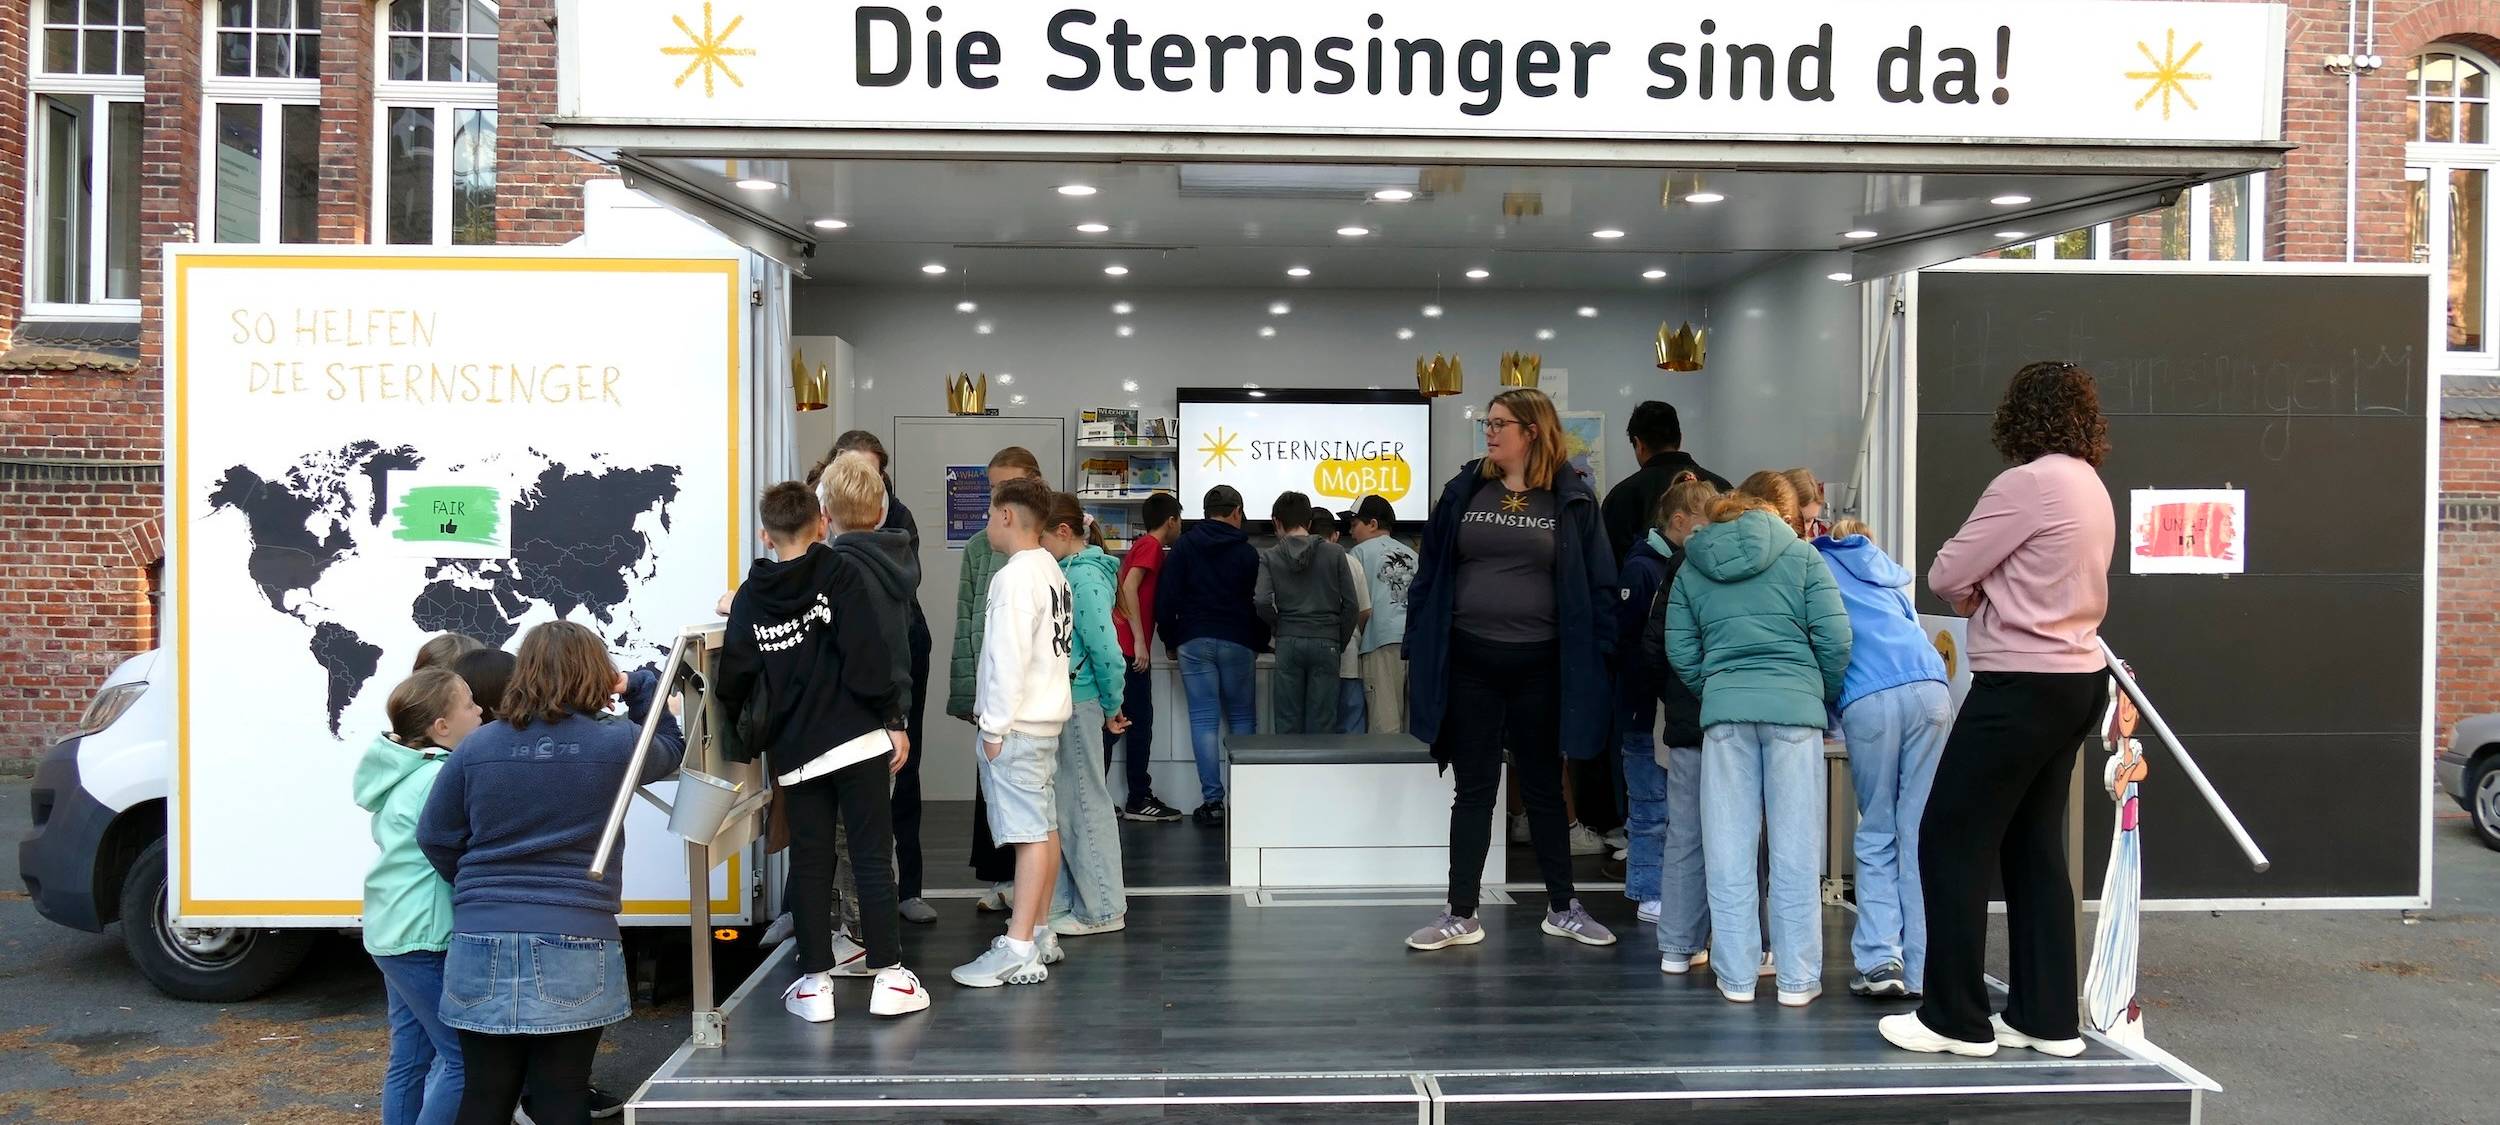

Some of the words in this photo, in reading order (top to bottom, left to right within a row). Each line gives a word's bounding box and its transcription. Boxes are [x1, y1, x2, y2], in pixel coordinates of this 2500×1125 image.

[855, 5, 1001, 89] Die
[1046, 8, 1611, 116] Sternsinger
[1647, 18, 1835, 101] sind
[1876, 24, 2011, 106] da!
[231, 308, 275, 345] SO
[295, 308, 437, 347] HELFEN
[249, 361, 309, 395] DIE
[326, 362, 622, 408] STERNSINGER
[1250, 439, 1406, 464] STERNSINGER
[1320, 466, 1405, 494] MOBIL
[433, 500, 465, 516] FAIR
